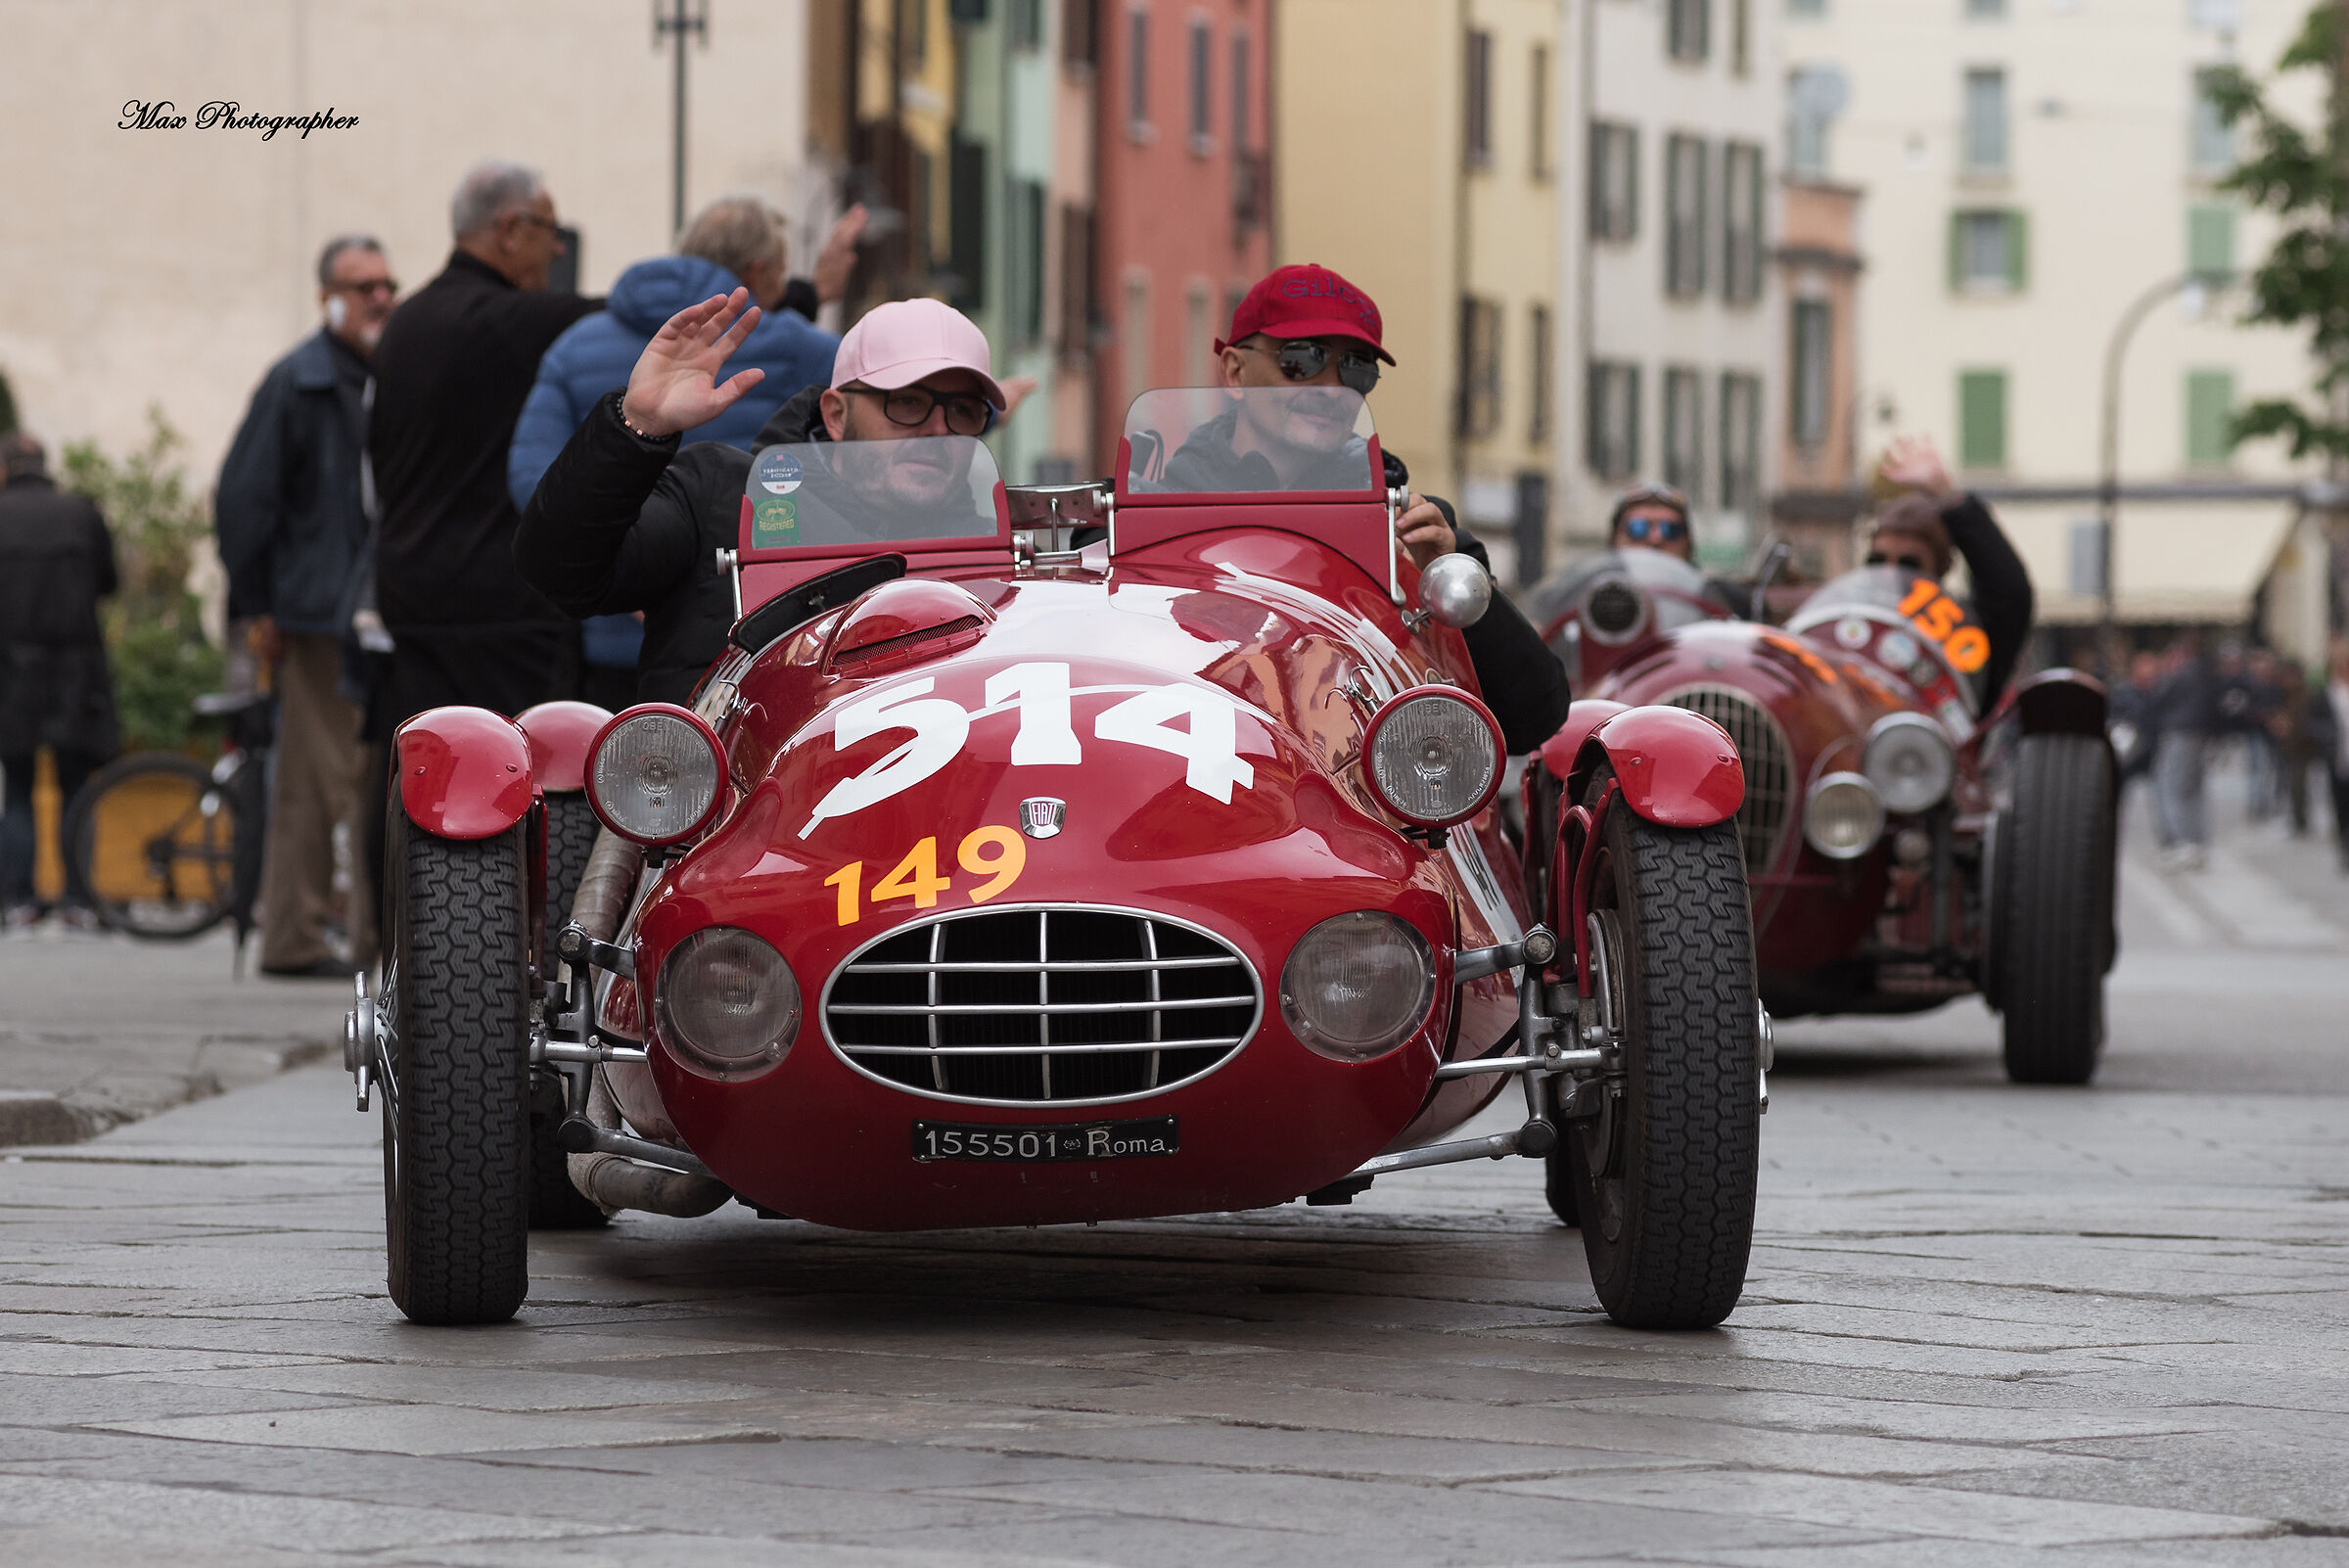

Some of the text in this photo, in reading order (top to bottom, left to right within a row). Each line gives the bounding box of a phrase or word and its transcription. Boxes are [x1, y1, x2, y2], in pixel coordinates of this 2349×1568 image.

[759, 518, 795, 531] REGISTERED
[1897, 578, 1991, 672] 150
[810, 662, 1254, 818] 514
[1032, 803, 1055, 825] FIAT
[824, 825, 1027, 926] 149
[925, 1129, 1165, 1159] 155501 Roma
